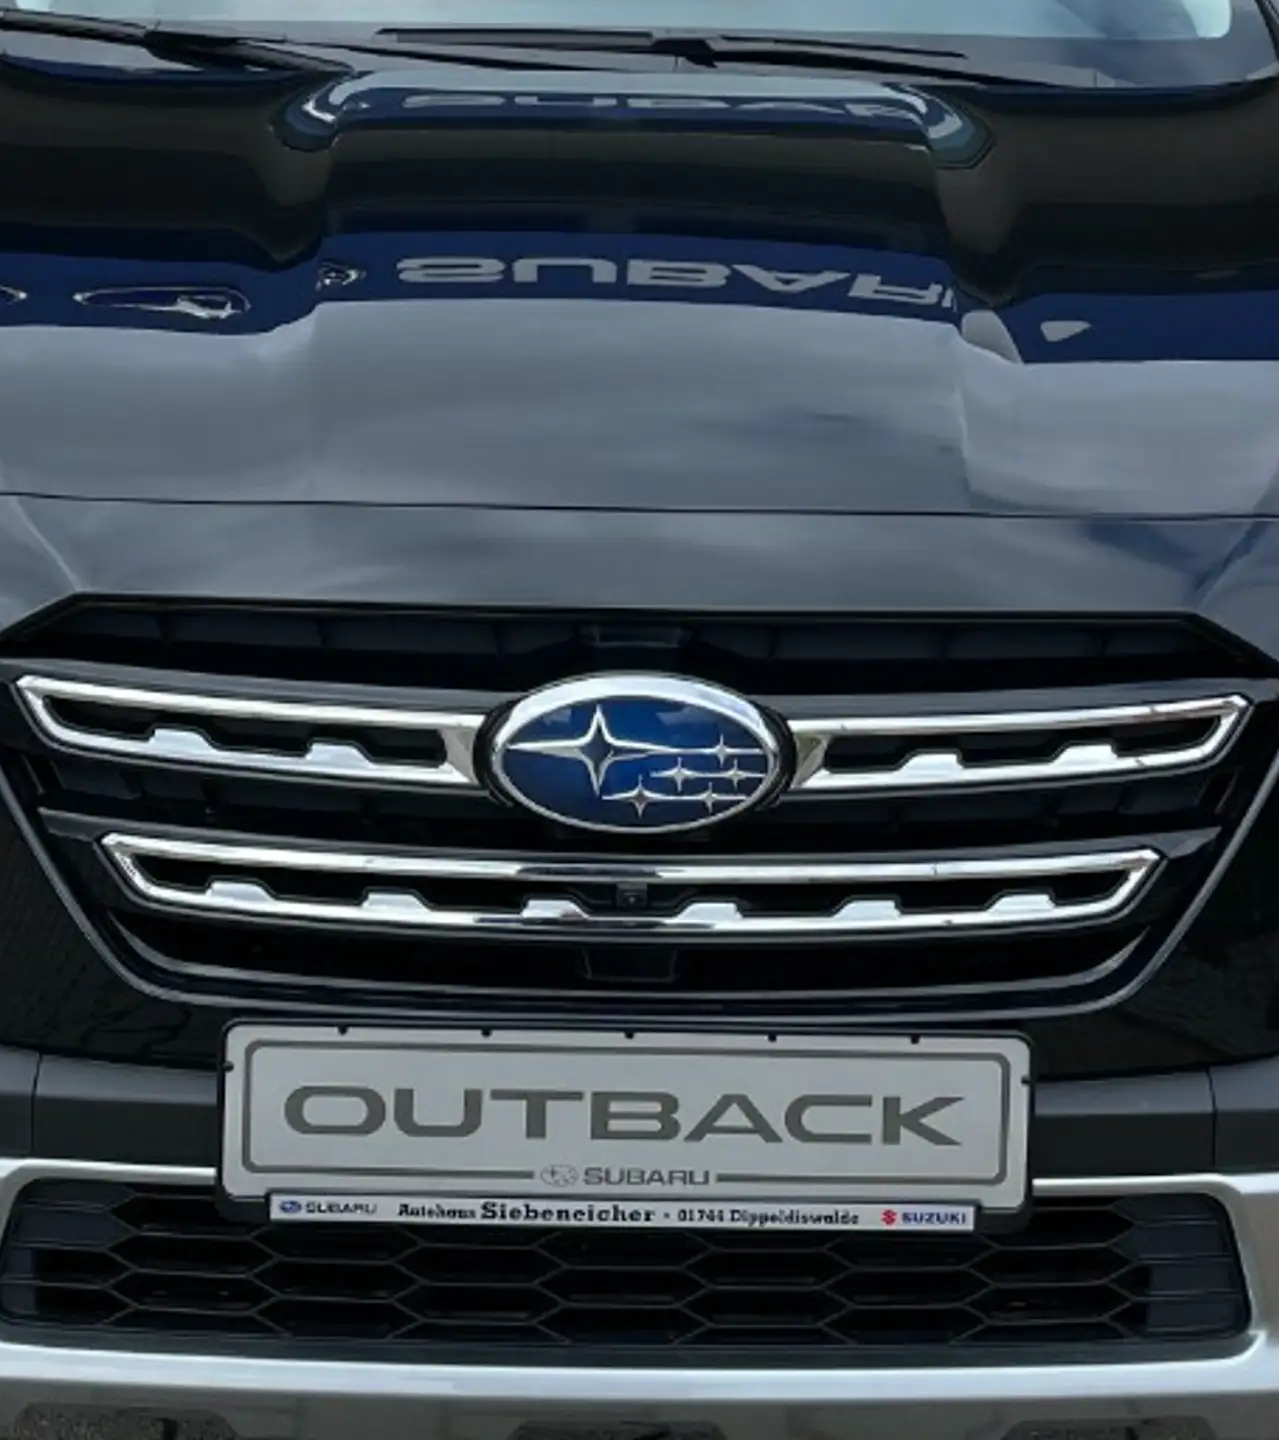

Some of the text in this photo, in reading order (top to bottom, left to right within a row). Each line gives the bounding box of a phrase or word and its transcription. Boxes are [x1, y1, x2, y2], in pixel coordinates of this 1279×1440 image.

[283, 1084, 966, 1147] OUTBACK
[582, 1167, 712, 1187] SUBARU
[397, 1202, 477, 1219] Autohaus
[480, 1201, 655, 1222] Siebeneicher
[901, 1211, 967, 1225] SUZUKI
